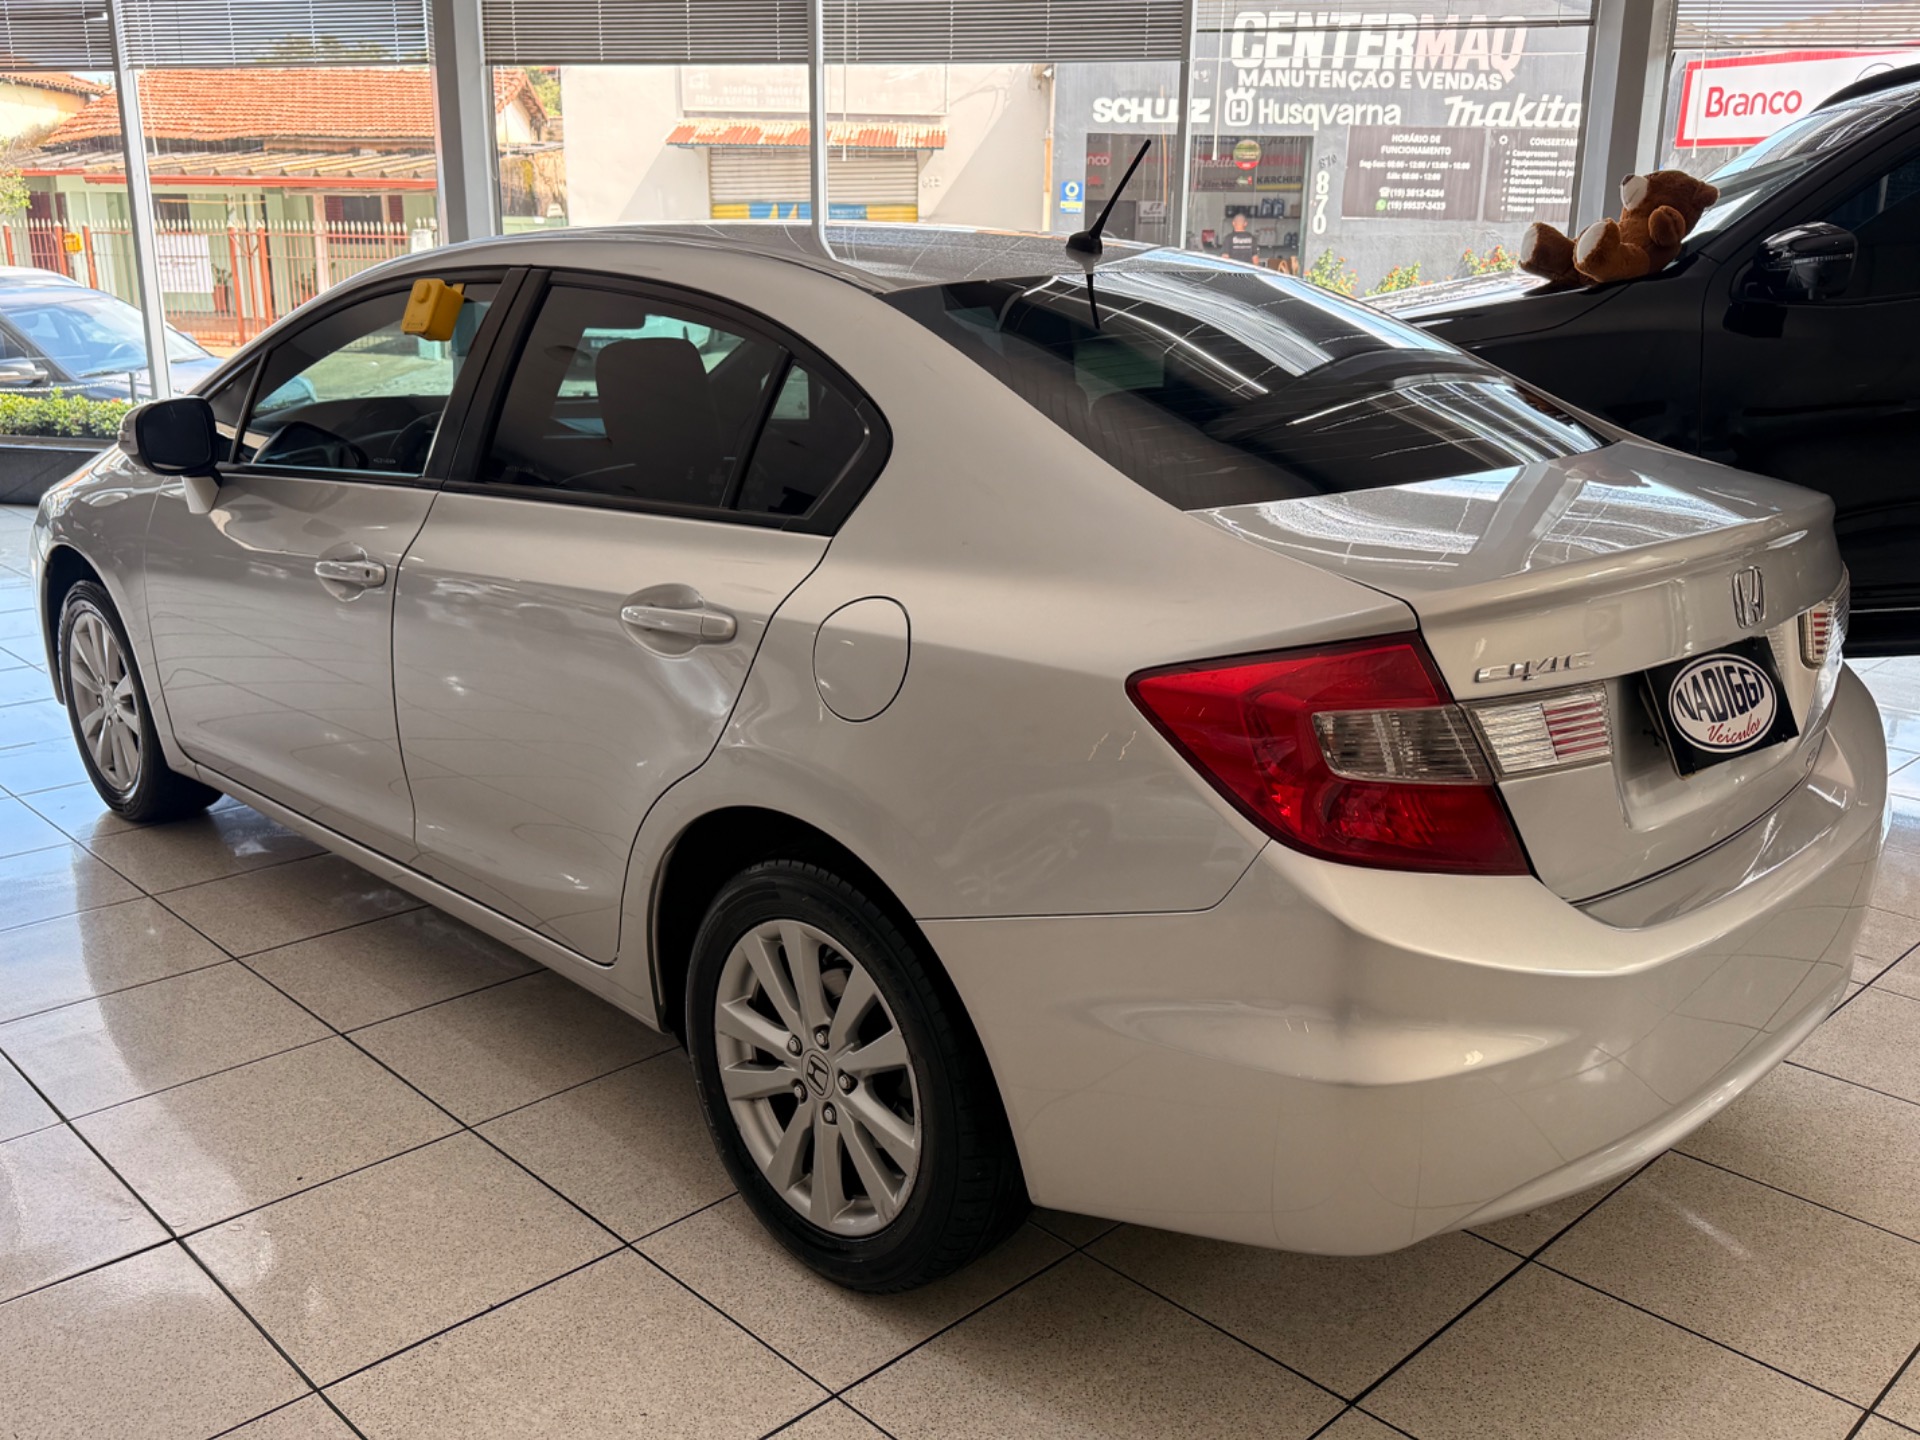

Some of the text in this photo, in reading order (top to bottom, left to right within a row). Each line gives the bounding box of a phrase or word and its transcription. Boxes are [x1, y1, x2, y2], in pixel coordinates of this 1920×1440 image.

[1231, 11, 1527, 84] CENTERMAQ
[1238, 68, 1503, 91] MANUTENÇÃO E VENDAS
[1258, 98, 1401, 131] Husqvarna
[1704, 86, 1802, 118] Branco
[1381, 145, 1451, 155] FUNCIONAMENTO
[1391, 132, 1441, 143] HORÁRIO DE
[1312, 170, 1330, 234] 870
[1473, 652, 1595, 683] CIVIC
[1676, 665, 1765, 723] NADIGGI
